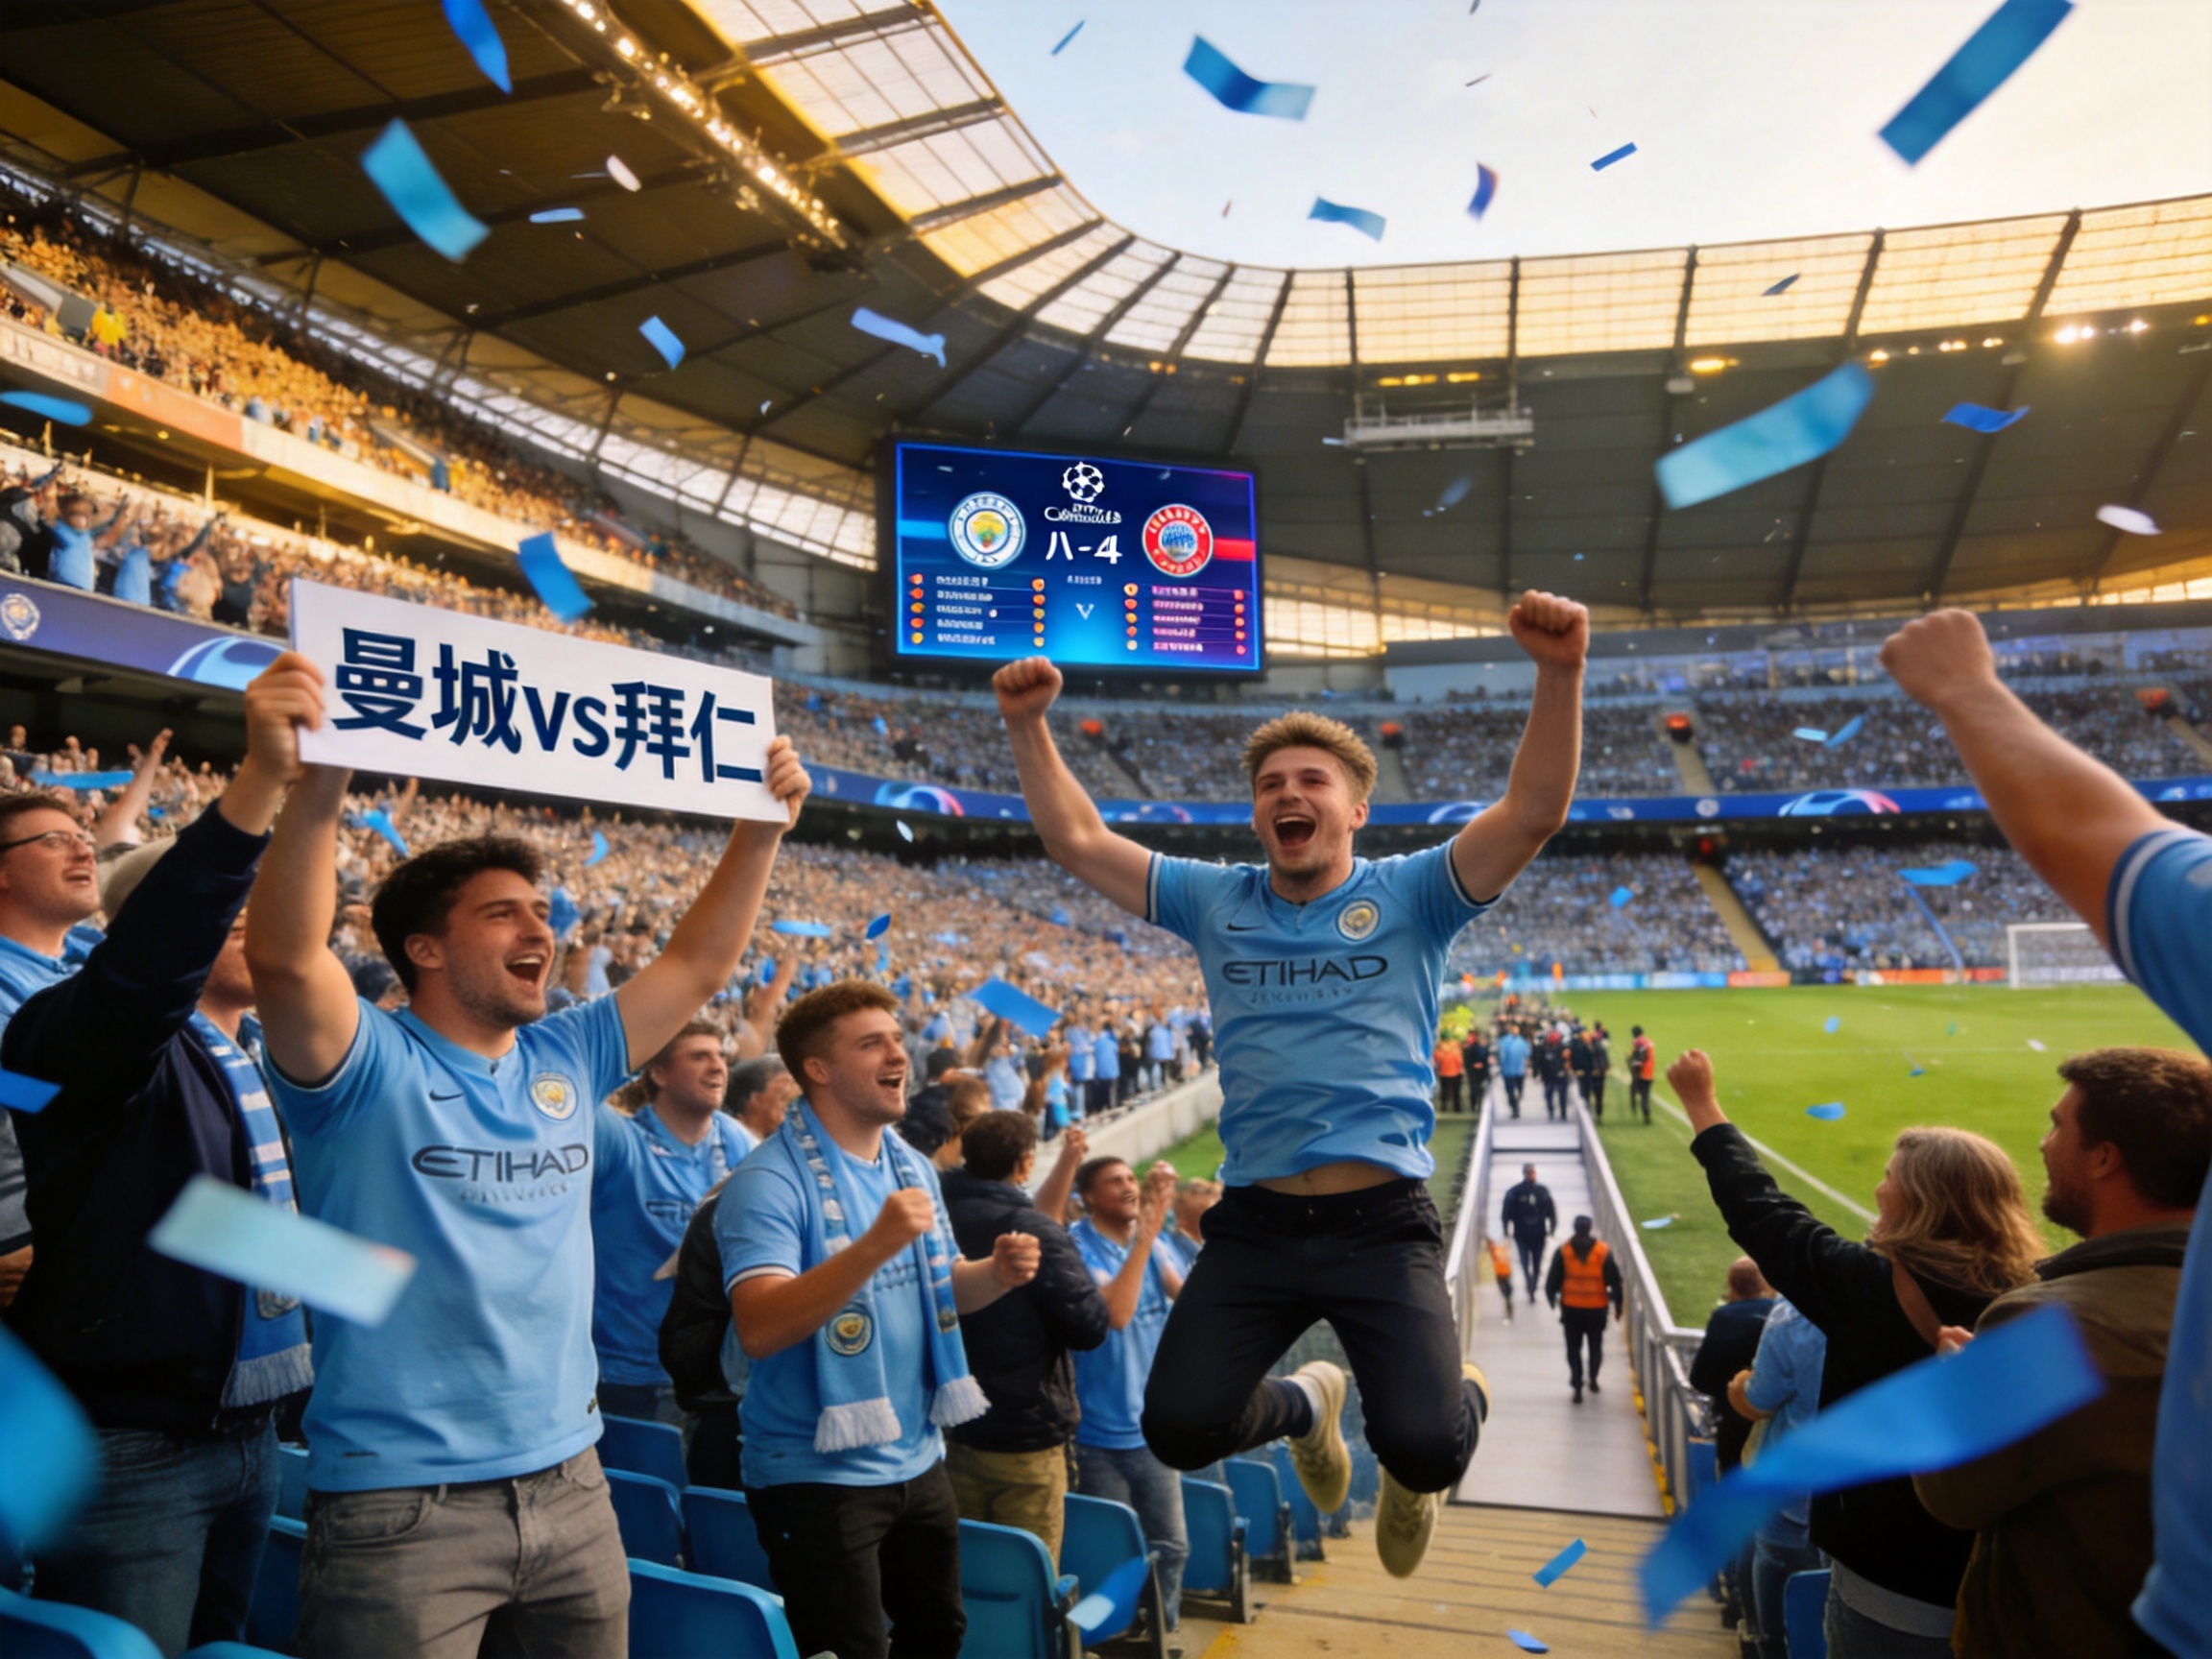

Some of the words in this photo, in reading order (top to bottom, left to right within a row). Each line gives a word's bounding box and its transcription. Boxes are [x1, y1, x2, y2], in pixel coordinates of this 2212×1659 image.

[332, 627, 763, 783] 曼城vs拜仁
[1222, 955, 1388, 986] ETIHAD
[411, 1142, 589, 1183] ETIHAD
